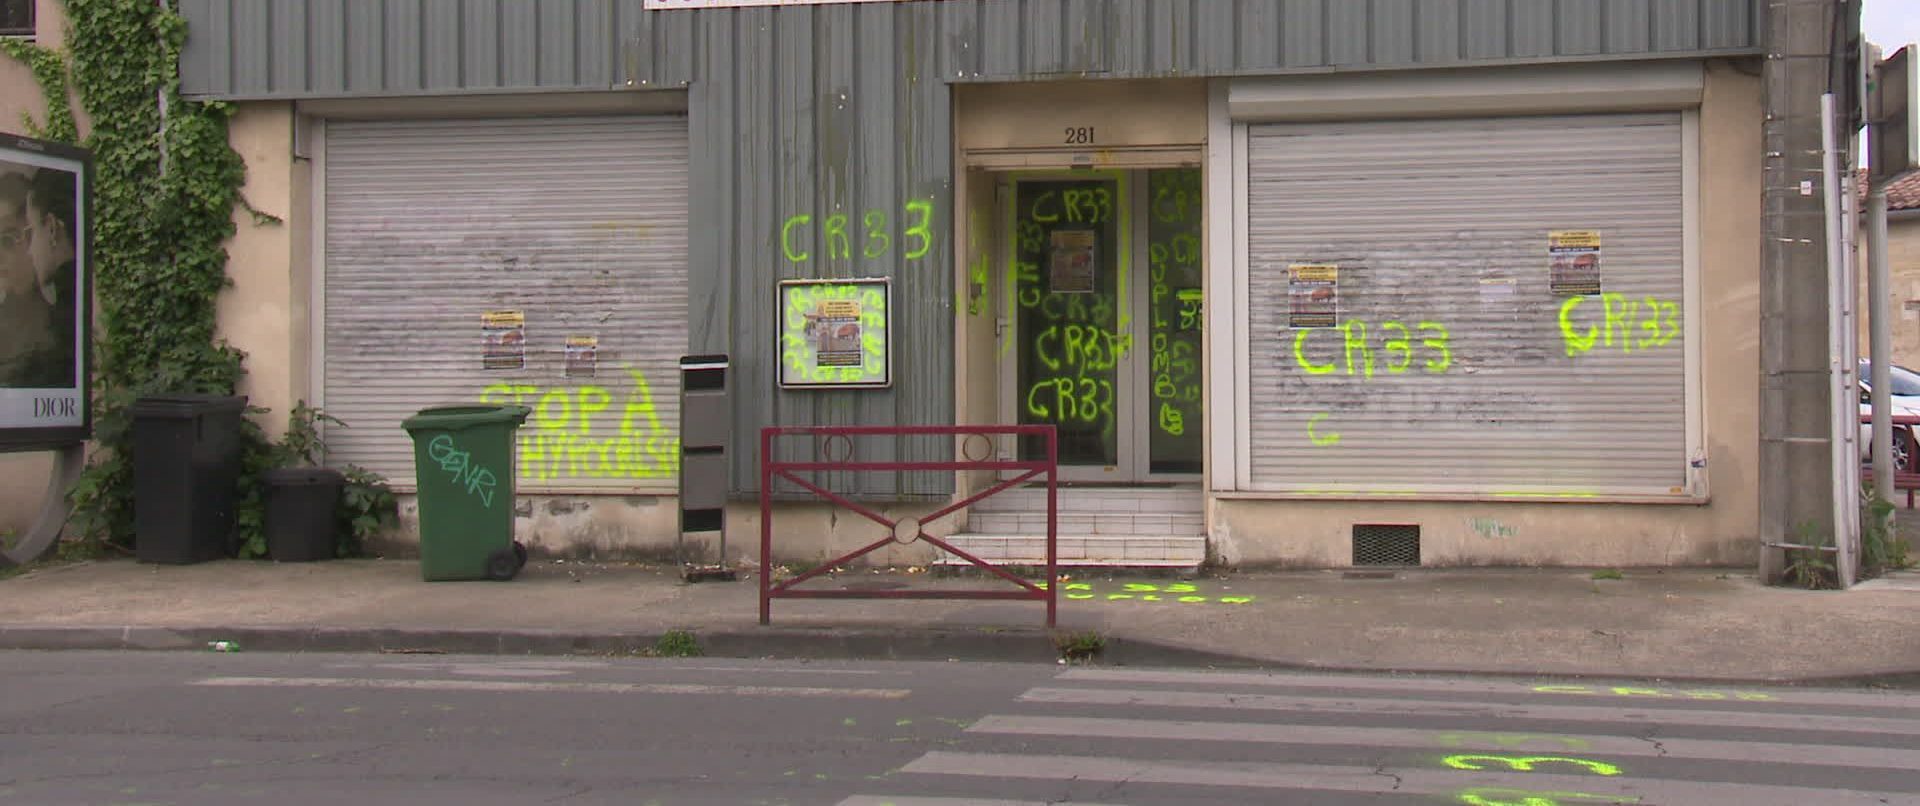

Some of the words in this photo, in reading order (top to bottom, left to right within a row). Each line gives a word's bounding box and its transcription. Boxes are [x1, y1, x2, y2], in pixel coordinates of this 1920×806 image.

[1064, 127, 1095, 144] 281
[1031, 188, 1113, 223] CR33
[783, 199, 932, 262] CR33
[1293, 319, 1452, 380] CR33
[34, 397, 76, 417] DIOR
[1028, 376, 1114, 424] CR33
